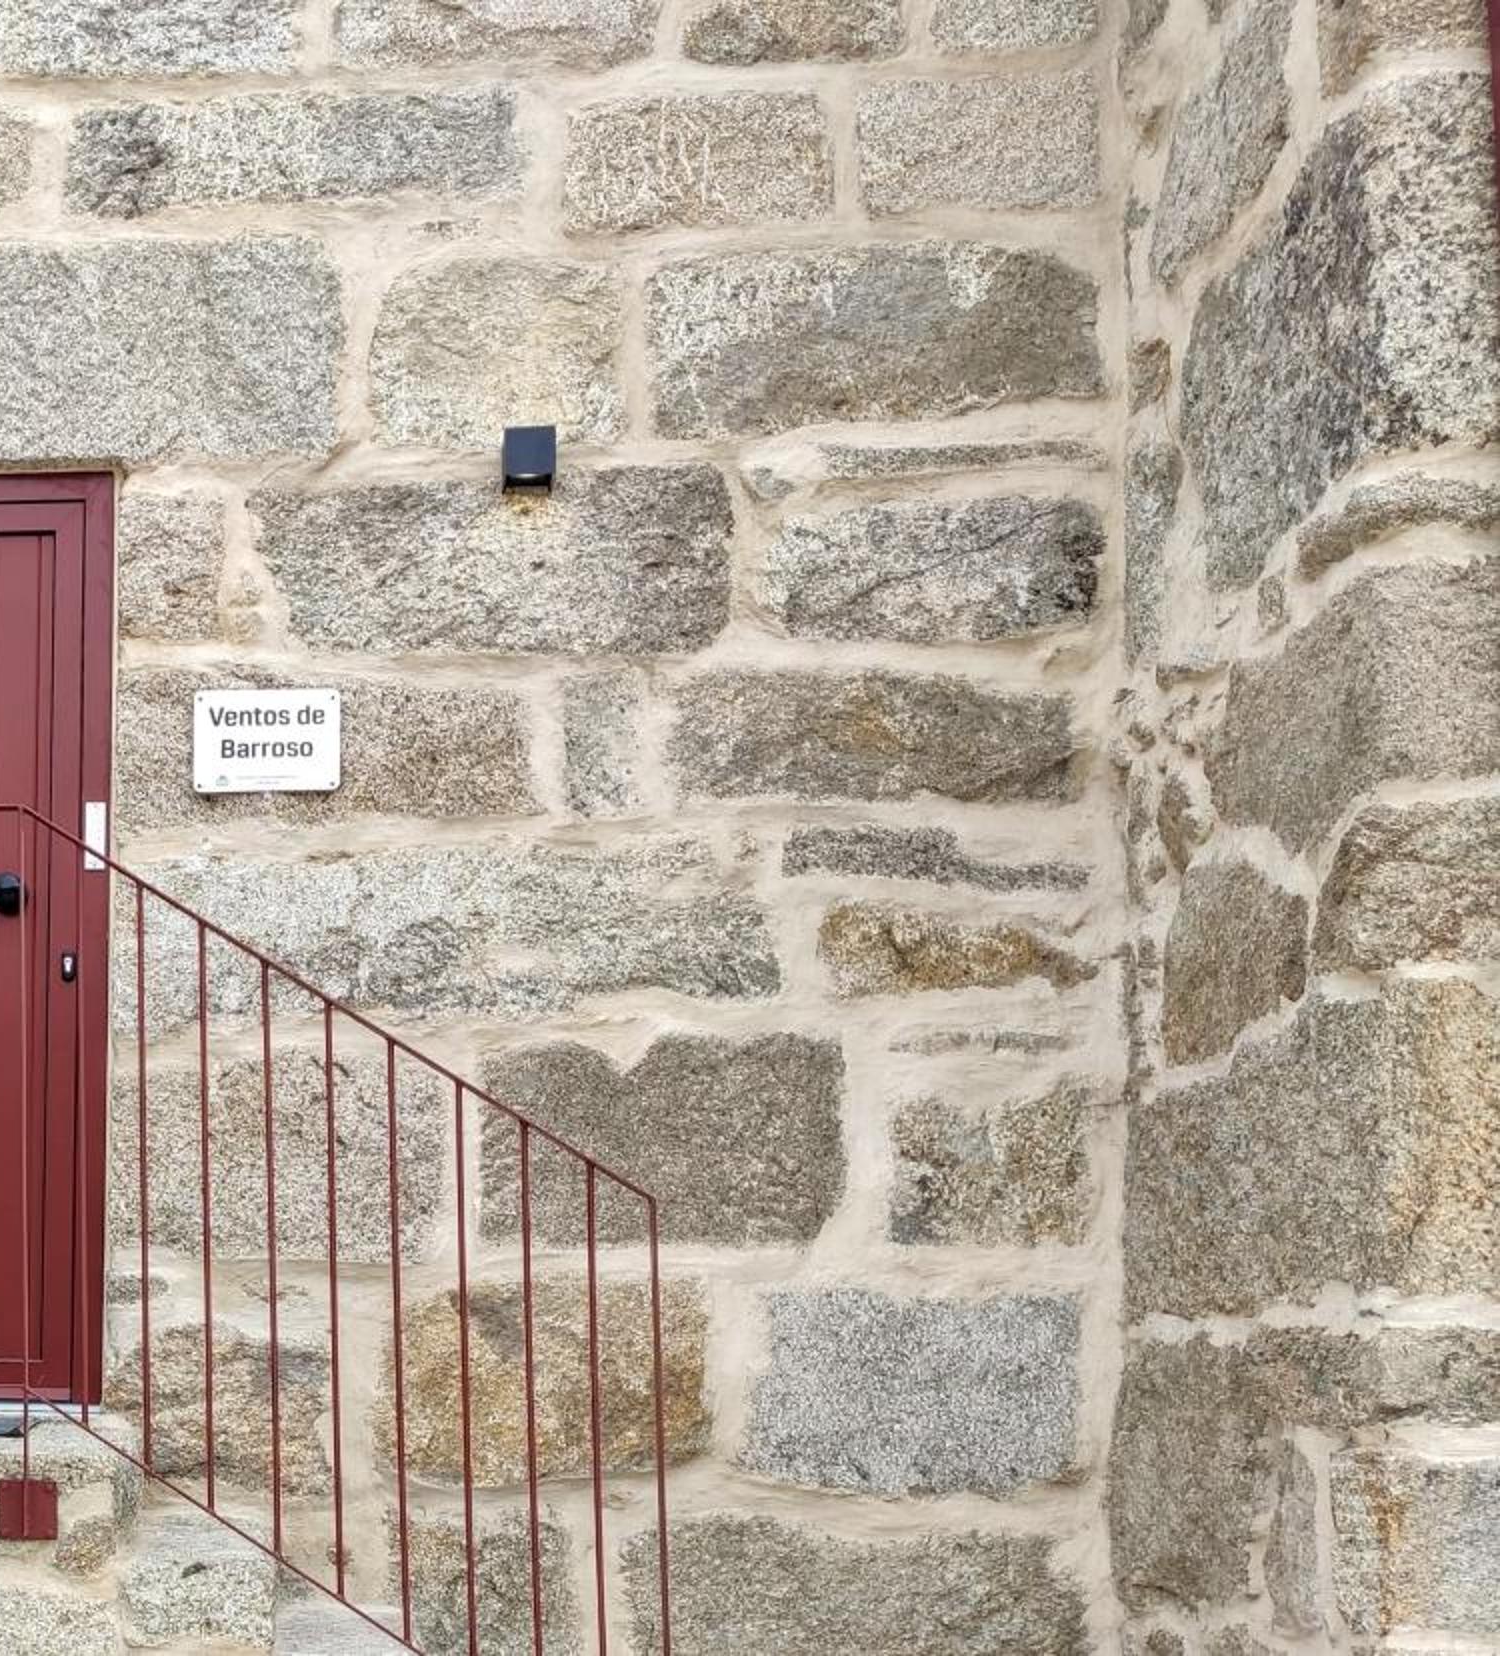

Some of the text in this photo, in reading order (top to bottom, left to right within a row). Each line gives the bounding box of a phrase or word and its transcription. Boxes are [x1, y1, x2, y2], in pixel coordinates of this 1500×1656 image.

[209, 705, 325, 727] Ventos de
[220, 738, 314, 759] Barroso
